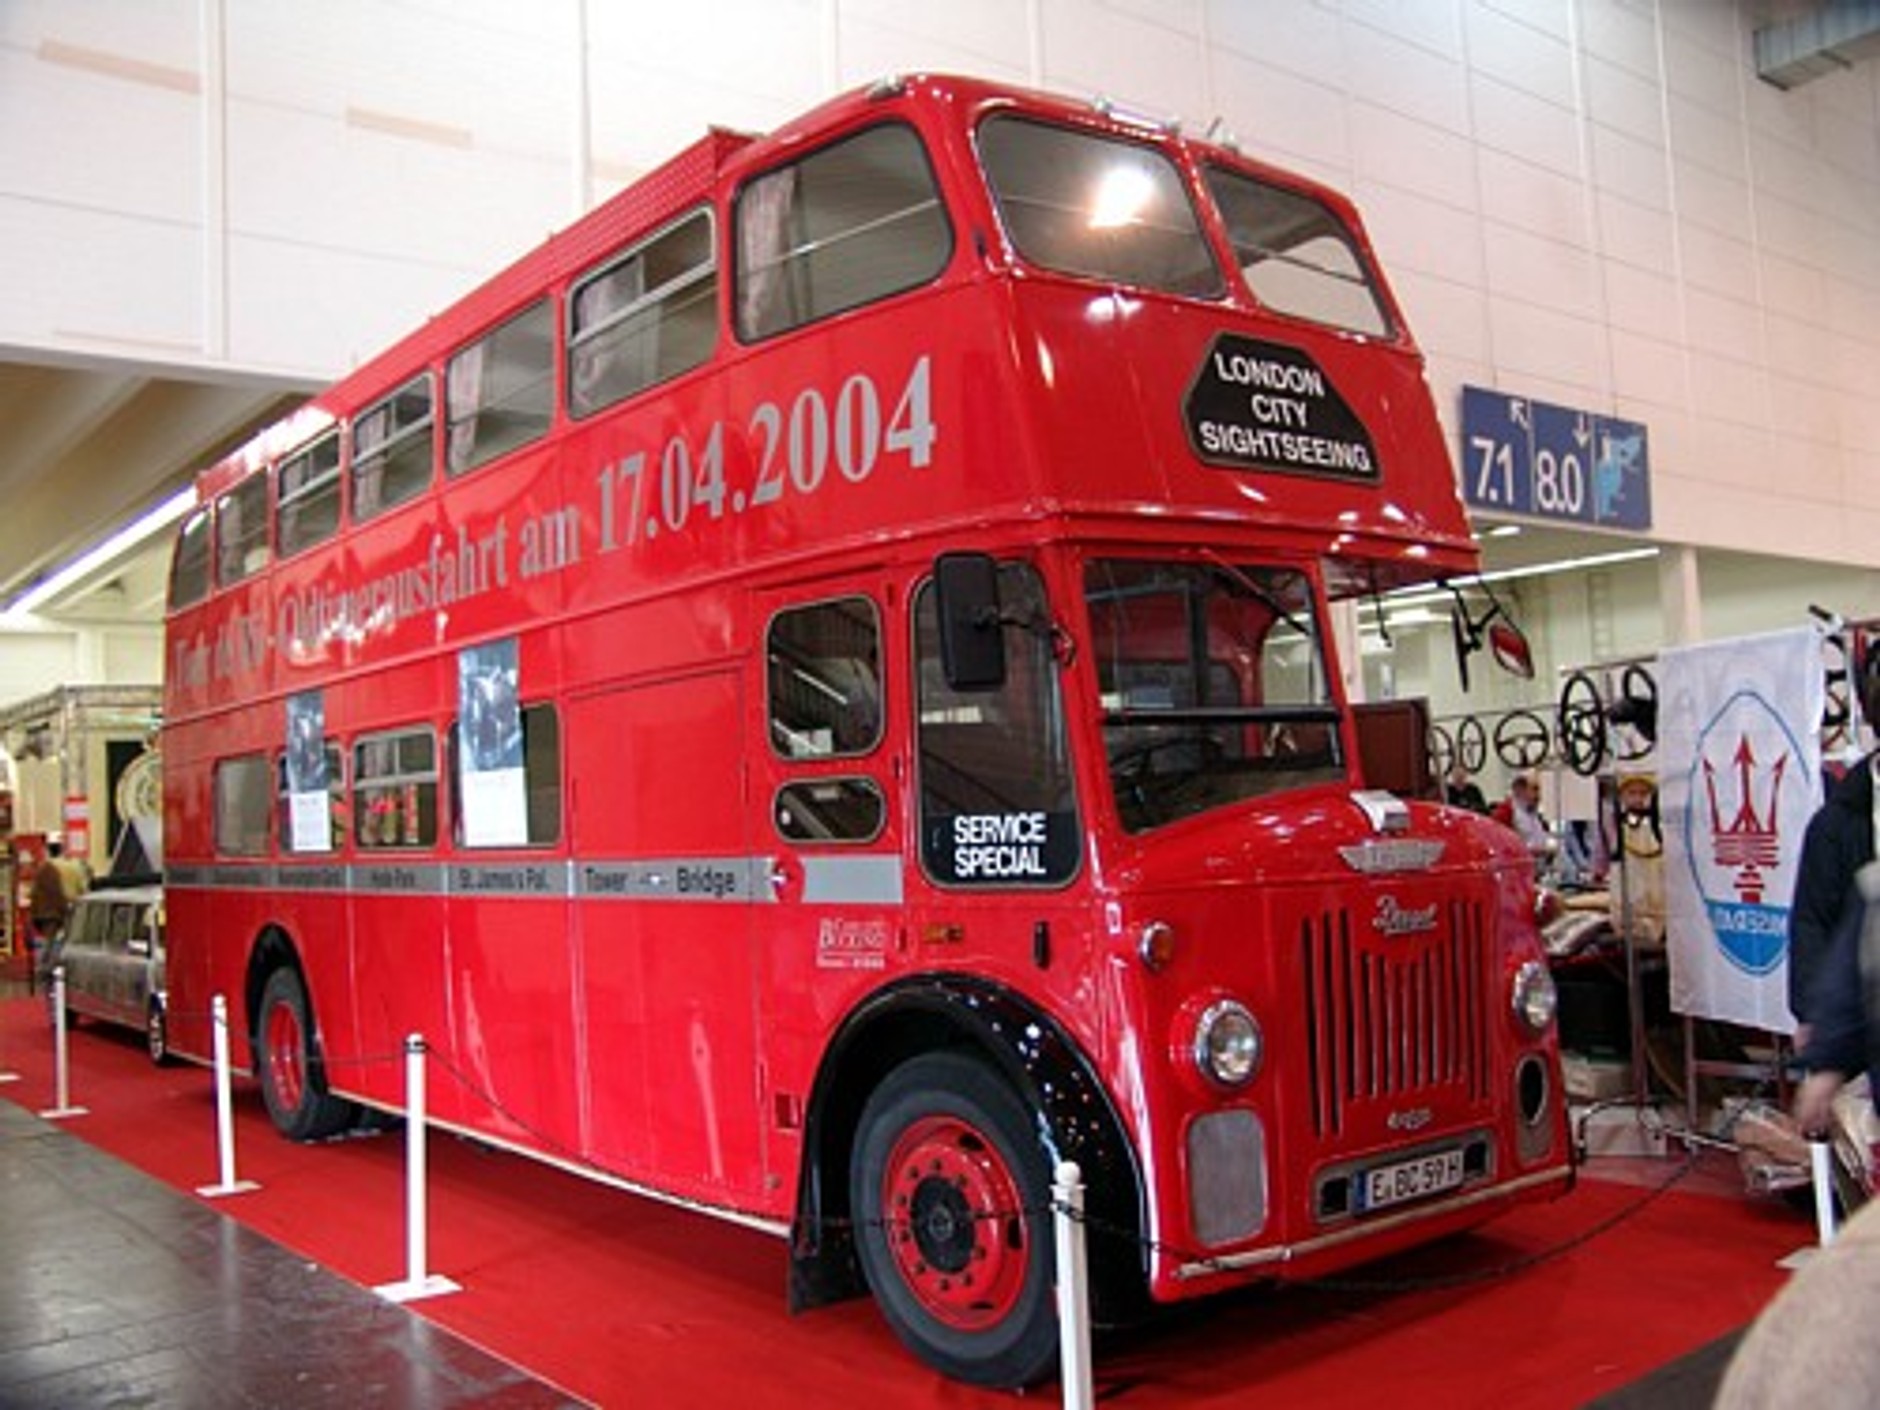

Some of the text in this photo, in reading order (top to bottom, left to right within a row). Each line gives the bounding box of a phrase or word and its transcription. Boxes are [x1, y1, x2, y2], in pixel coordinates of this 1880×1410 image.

[1213, 352, 1325, 398] LONDON
[1251, 394, 1308, 428] CITY
[518, 504, 582, 580] am
[597, 355, 938, 554] 17.04.2004
[1199, 420, 1373, 472] SIGHTSEEING
[1471, 435, 1515, 505] 7.1
[1536, 449, 1584, 515] 8.0
[953, 811, 1047, 844] SERVICE
[585, 867, 736, 898] Tower Bridge
[953, 845, 1047, 877] SPECIAL
